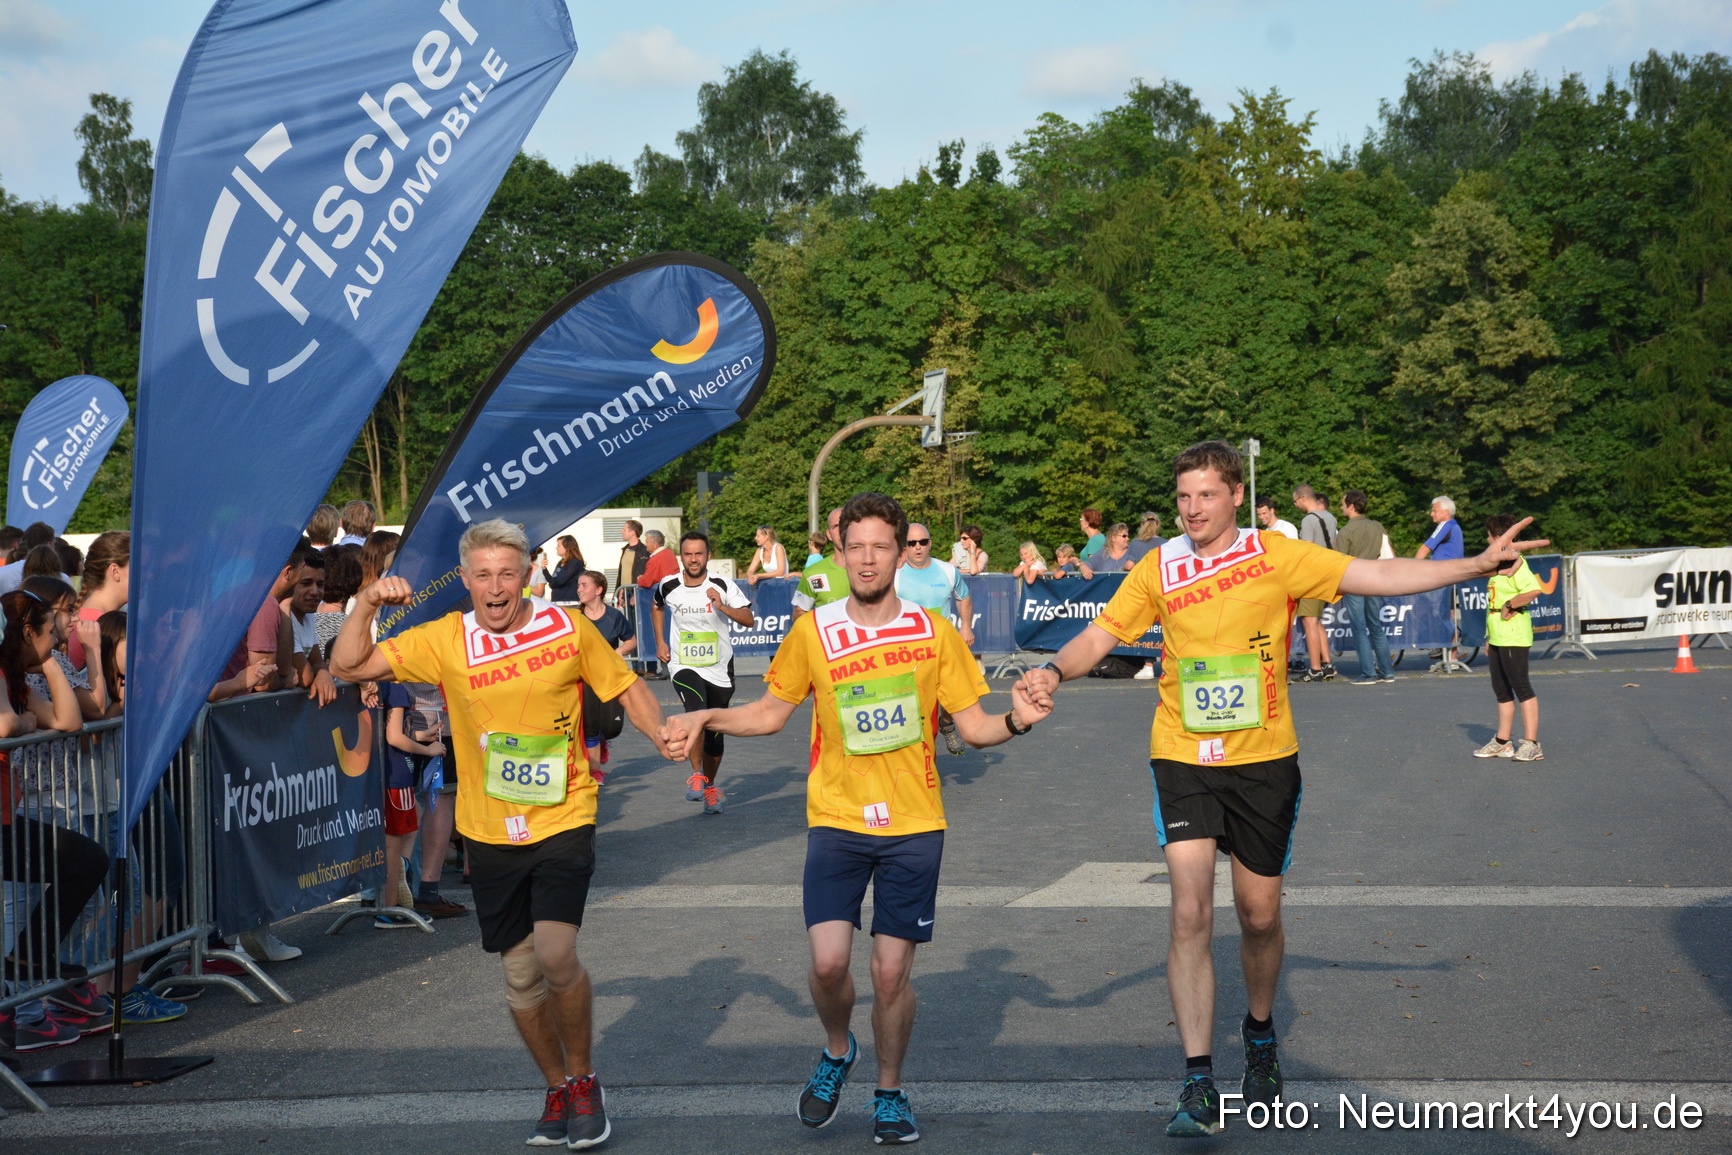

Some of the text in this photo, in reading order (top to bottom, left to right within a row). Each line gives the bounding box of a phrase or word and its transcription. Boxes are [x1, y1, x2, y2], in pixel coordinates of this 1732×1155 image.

[254, 0, 479, 326] Fischer
[342, 47, 509, 321] AUTOMOBILE
[598, 355, 753, 457] Druck und Medien
[38, 396, 101, 493] Fischer
[63, 414, 110, 491] AUTOMOBILE
[447, 371, 677, 523] Frischmann
[674, 603, 713, 616] Xplus1
[1165, 560, 1275, 616] MAX BÖGL
[1654, 569, 1732, 608] swn
[1656, 609, 1709, 625] stadtwerke
[469, 643, 580, 691] MAX BÖGL
[683, 645, 714, 657] 1604
[829, 647, 937, 682] MAX BÖGL
[856, 704, 907, 733] 884
[1195, 685, 1245, 711] 932
[501, 760, 551, 786] 885
[224, 762, 338, 832] Frischmann
[297, 803, 381, 849] Druck und Medien
